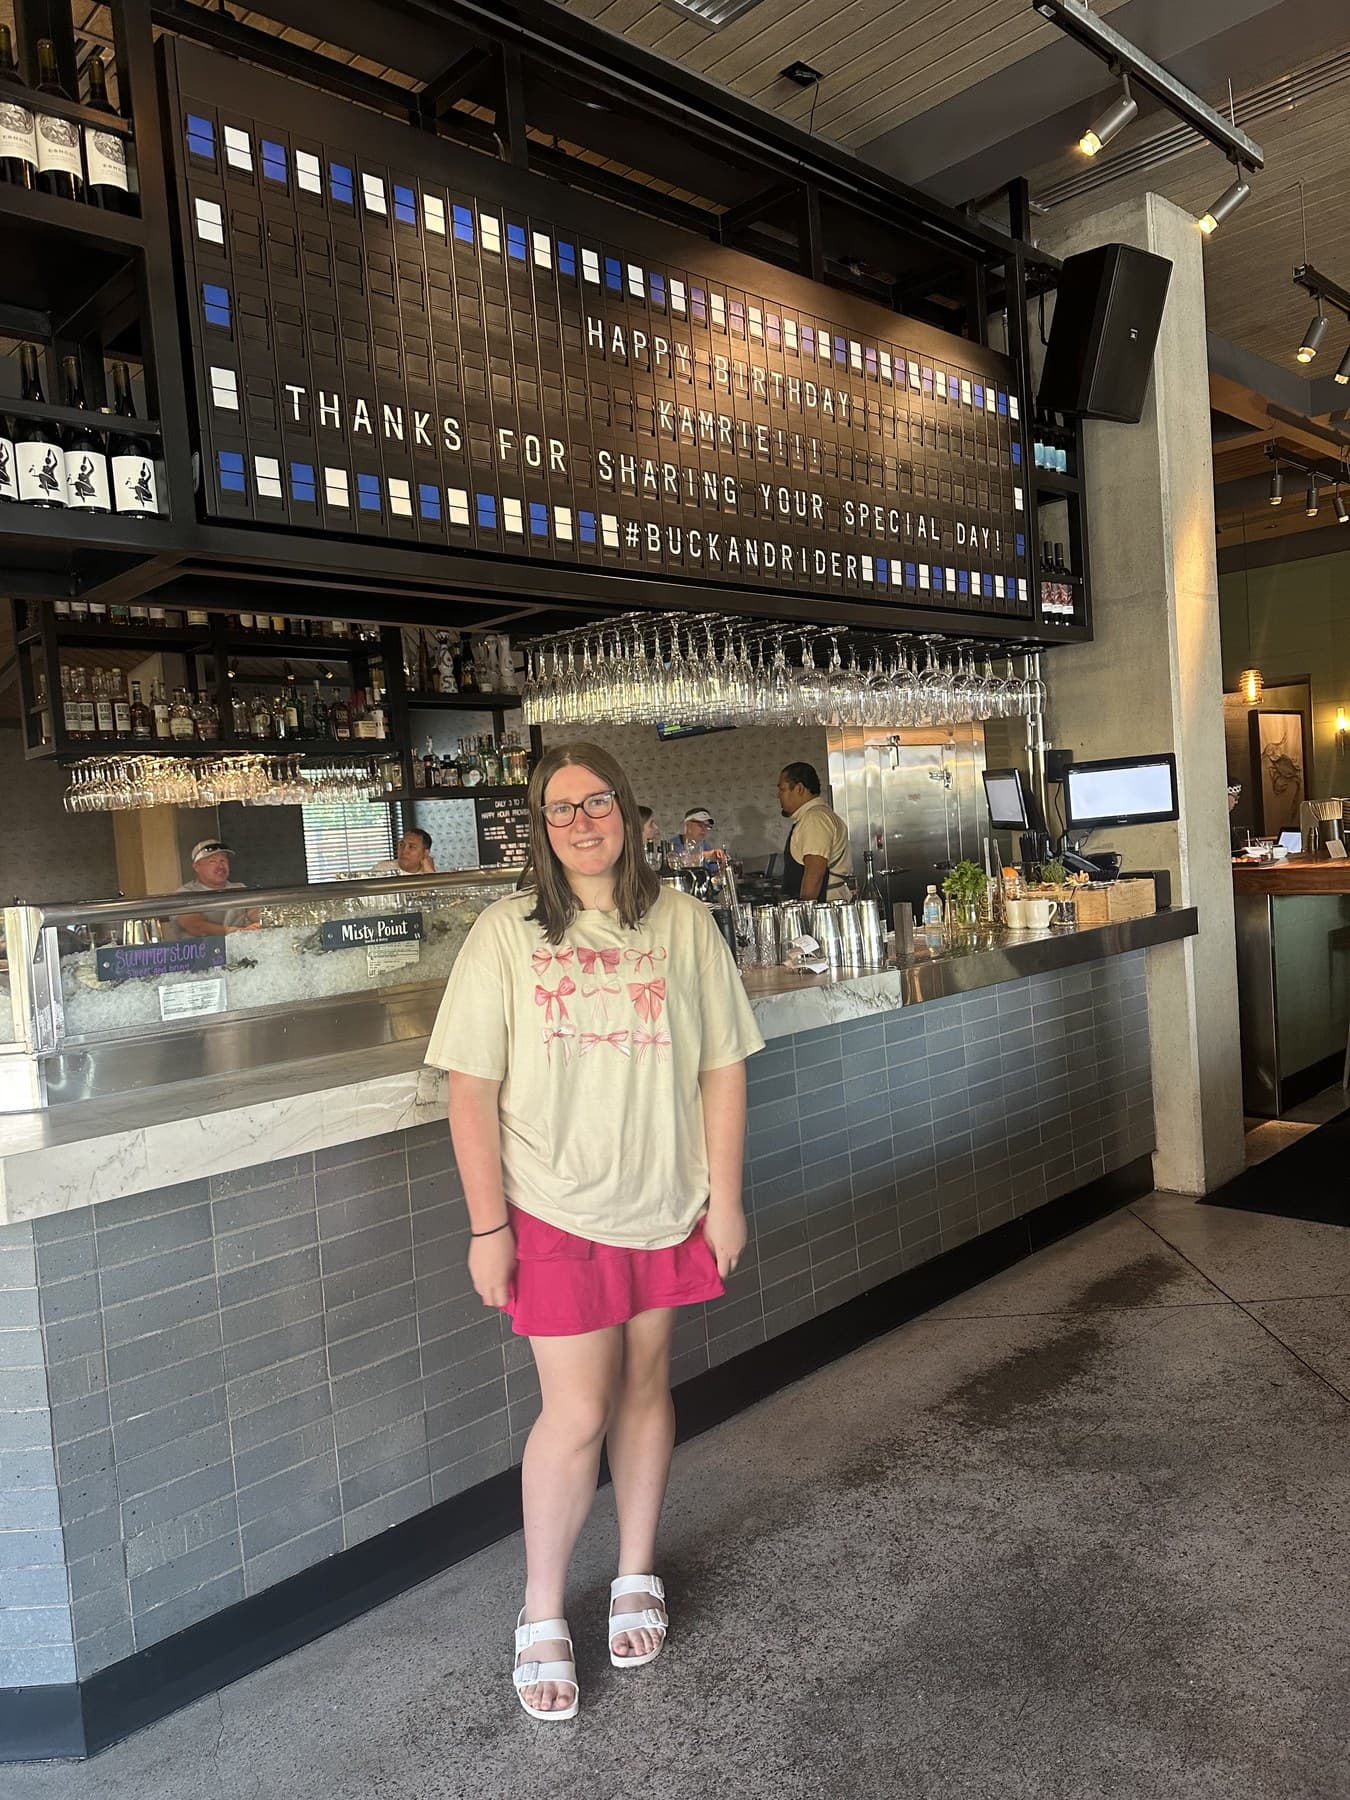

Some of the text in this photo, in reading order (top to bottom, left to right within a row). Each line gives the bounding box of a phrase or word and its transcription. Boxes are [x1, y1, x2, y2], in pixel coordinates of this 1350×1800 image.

[586, 316, 850, 417] HAPPY BIRTHDAY
[658, 400, 818, 464] KAMRIE!!!
[284, 384, 1001, 551] THANKS FOR SHARING YOUR SPECIAL DAY!
[625, 522, 858, 579] #BUCKANDRIDER
[341, 919, 409, 942] Misty Point
